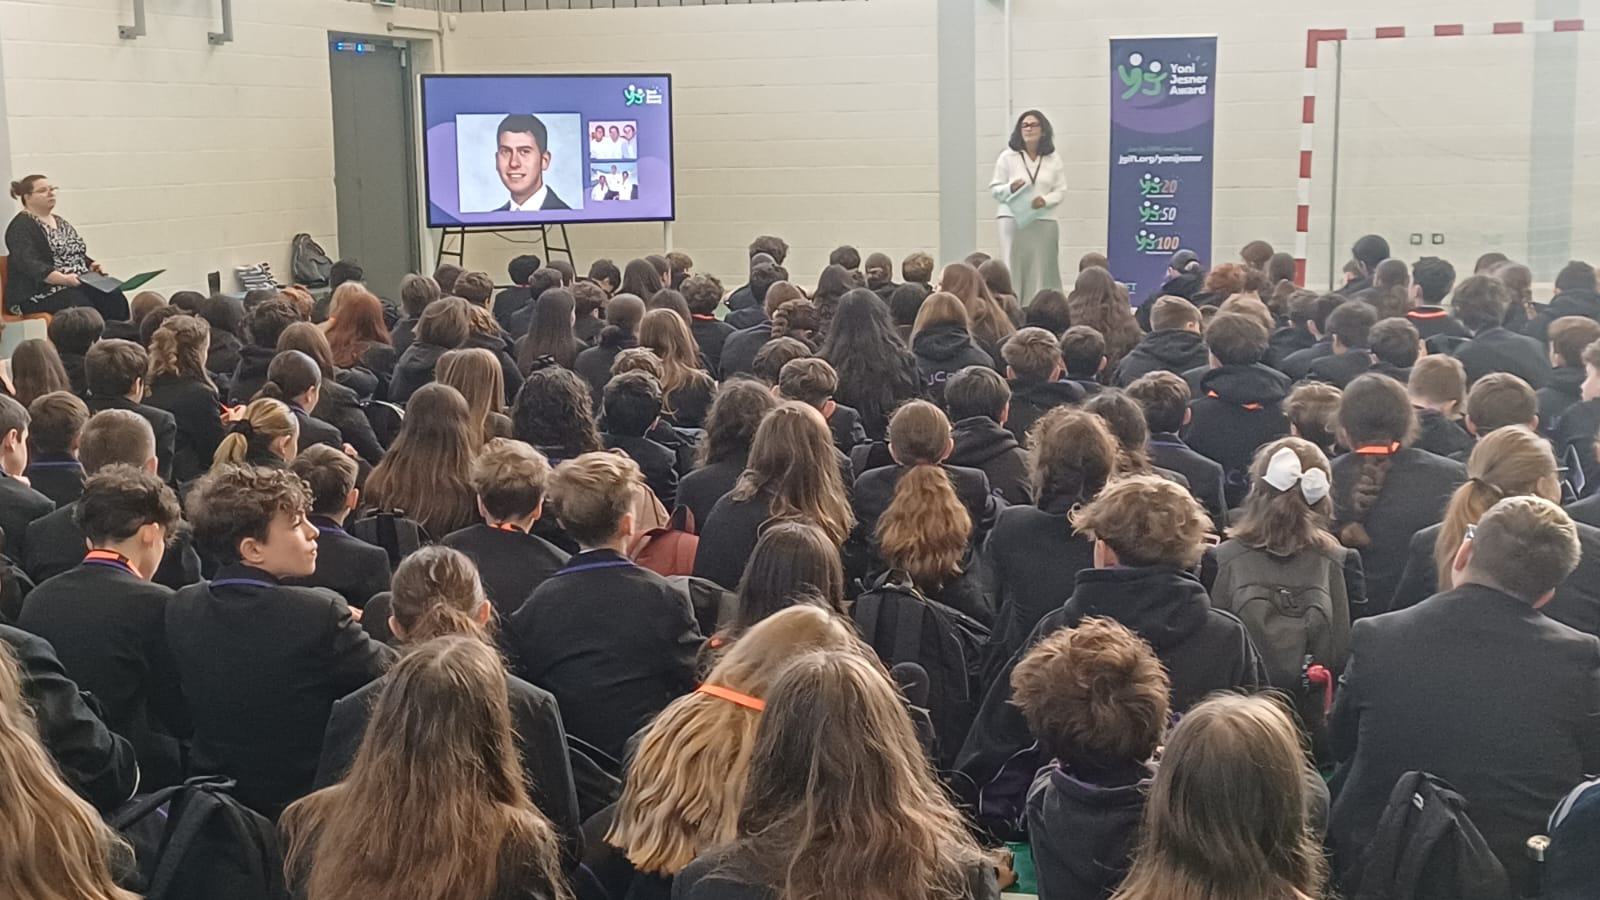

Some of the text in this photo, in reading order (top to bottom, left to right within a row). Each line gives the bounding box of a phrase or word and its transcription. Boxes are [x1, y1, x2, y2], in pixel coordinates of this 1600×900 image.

[1170, 63, 1196, 73] Yoni
[1169, 74, 1208, 85] Jesner
[1169, 85, 1206, 95] Award
